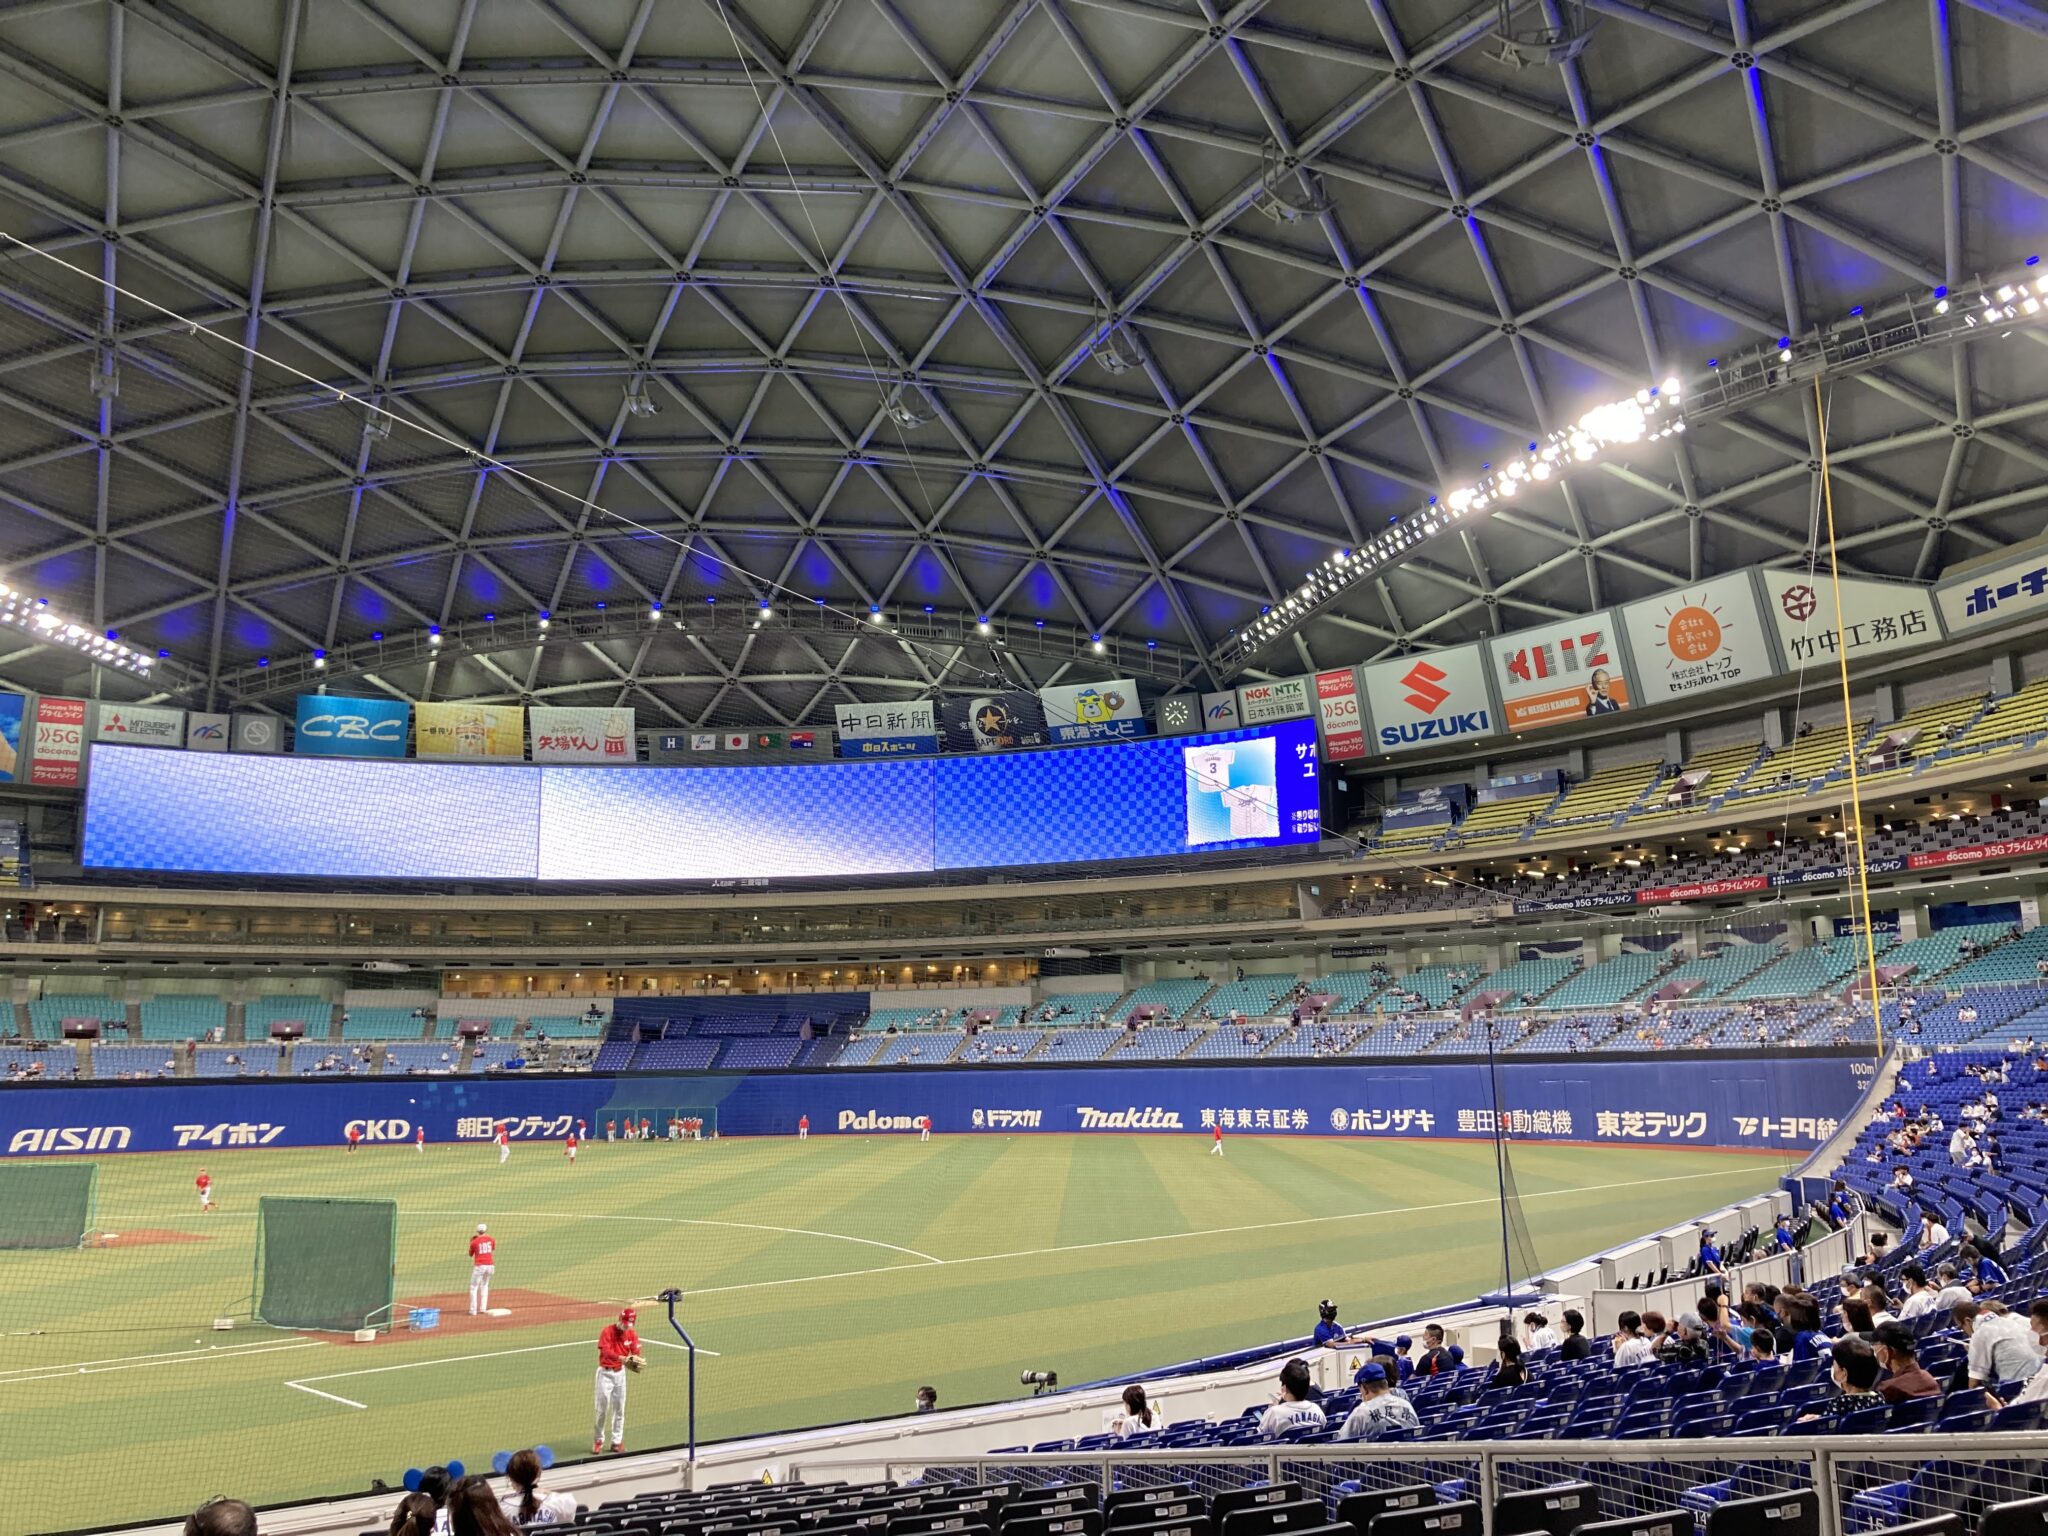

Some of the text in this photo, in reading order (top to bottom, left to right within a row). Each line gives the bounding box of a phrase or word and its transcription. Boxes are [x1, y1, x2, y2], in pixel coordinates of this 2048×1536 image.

[1790, 609, 1927, 660] 竹中工務店
[1503, 631, 1609, 685] KEIZ
[1706, 655, 1732, 672] トップ
[1721, 668, 1741, 679] TOP
[1245, 682, 1301, 700] NGK NTK
[1334, 700, 1357, 717] 5G
[130, 719, 176, 730] MITSUBISHI
[302, 715, 401, 740] CBC
[841, 711, 933, 731] 中日新聞
[1327, 720, 1359, 730] docomo
[1380, 710, 1489, 746] SUZUKI
[52, 729, 79, 744] 5G
[129, 727, 169, 737] ELECTRIC
[1059, 721, 1135, 740] 東海テレビ
[37, 746, 78, 756] docomo
[539, 736, 599, 751] 矢場とん
[1209, 762, 1217, 774] 3
[1946, 850, 1983, 861] docomo
[1802, 871, 1835, 881] docomo
[1670, 888, 1700, 898] docomo
[1544, 901, 1574, 910] docomo
[838, 1109, 926, 1130] Paloma
[1200, 1107, 1309, 1130] 東海東京証券
[1350, 1108, 1435, 1132] ホシザキ
[1596, 1110, 1707, 1138] 東芝テック
[174, 1122, 286, 1146] アイホン
[344, 1120, 410, 1140] CKD
[9, 1126, 131, 1152] AISIN
